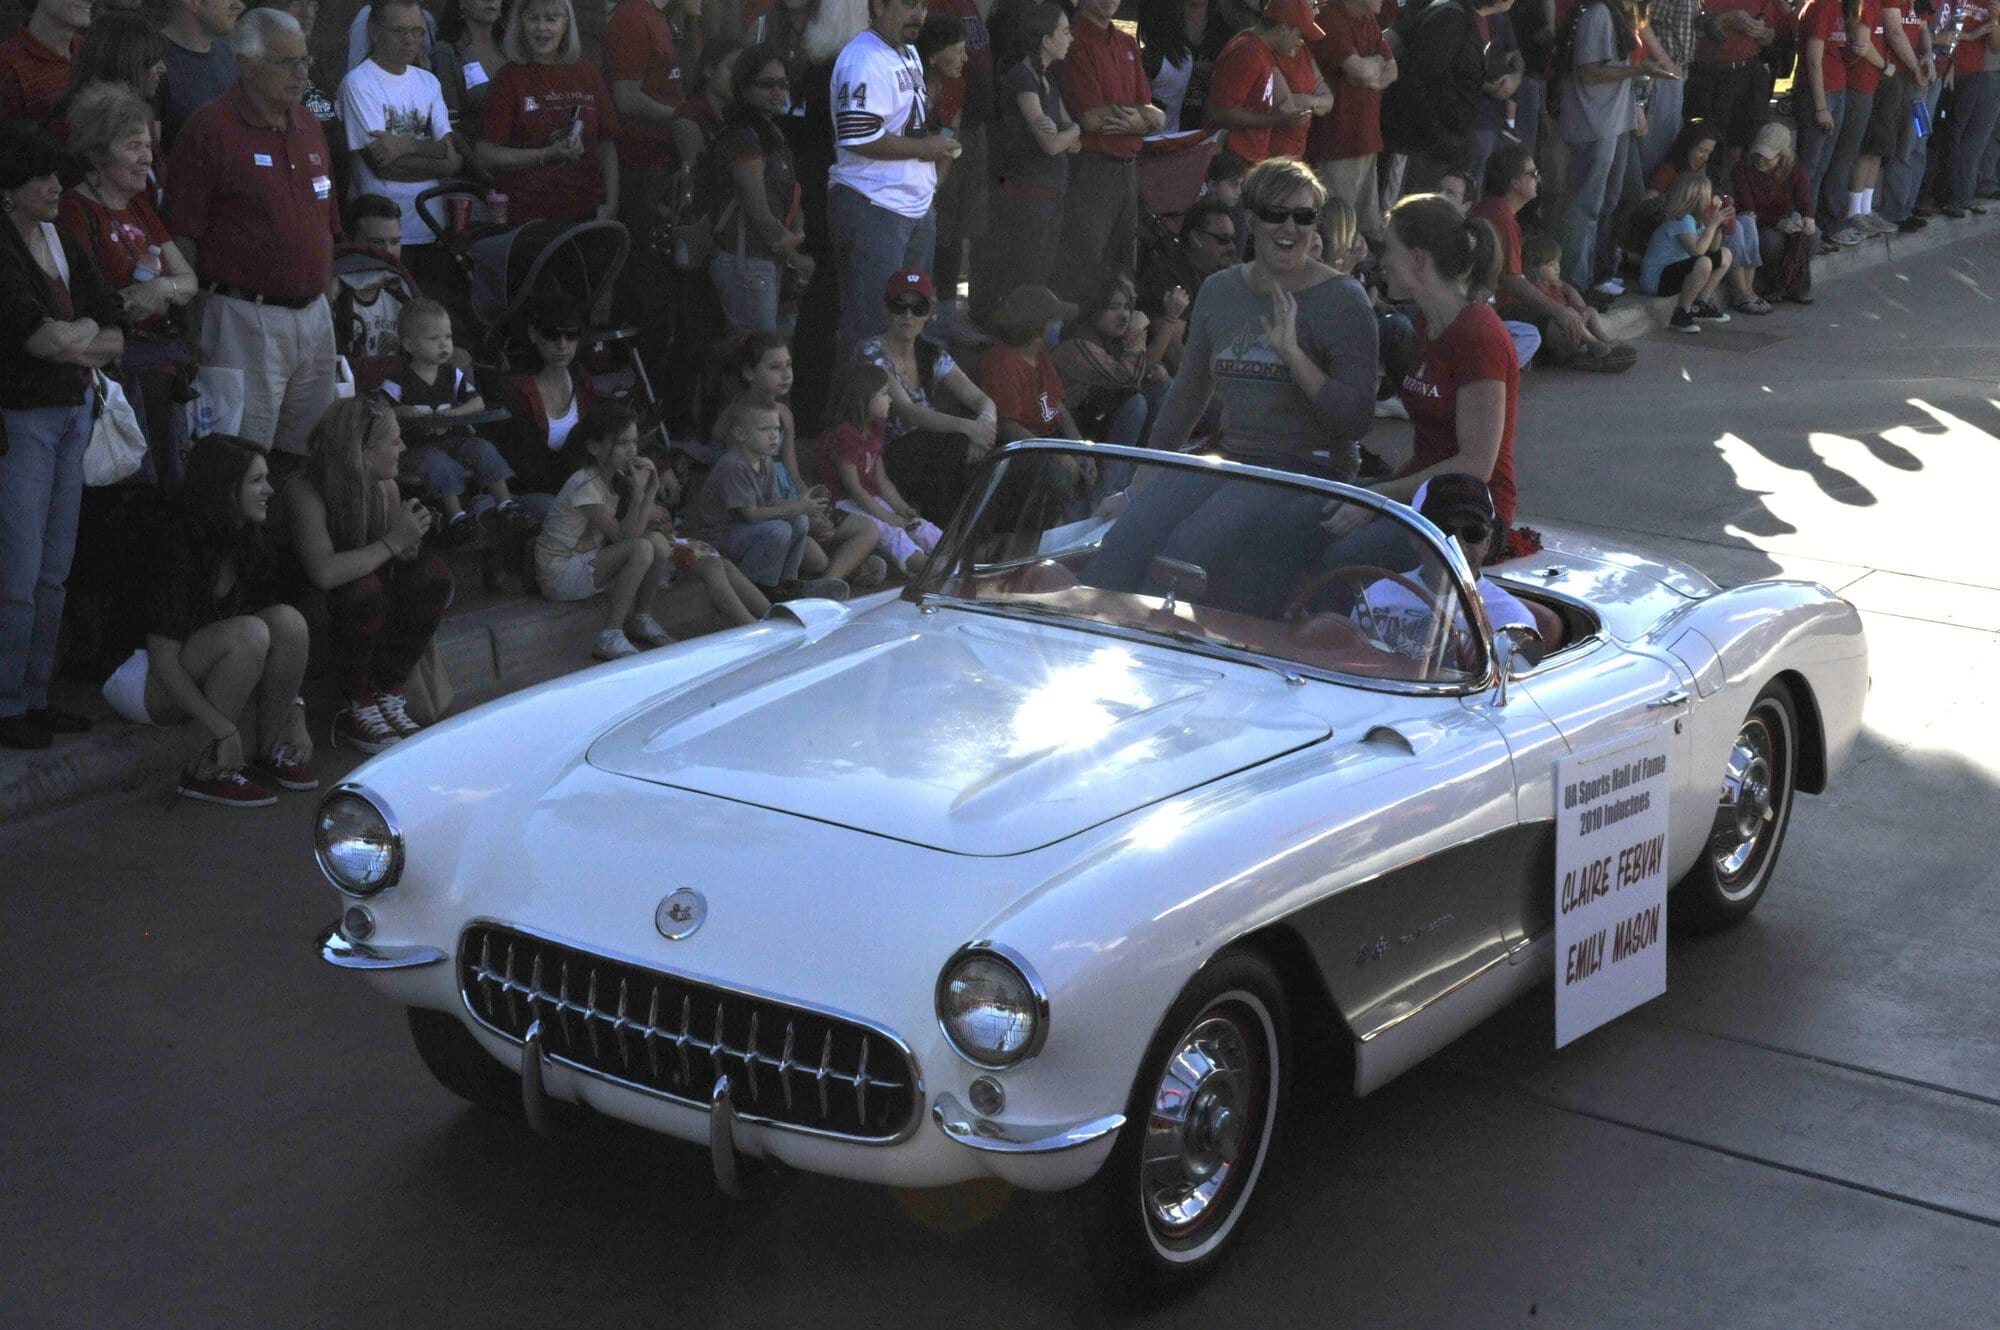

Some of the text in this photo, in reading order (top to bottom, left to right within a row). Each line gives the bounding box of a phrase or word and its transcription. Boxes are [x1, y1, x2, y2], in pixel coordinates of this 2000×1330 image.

[837, 82, 866, 109] 44
[1564, 754, 1666, 809] UA Sports Hall of Fame
[1580, 791, 1650, 836] 2010 Inductees
[1562, 834, 1665, 914] CLAIRE FEBVAY
[1566, 904, 1660, 985] EMILY MASON
